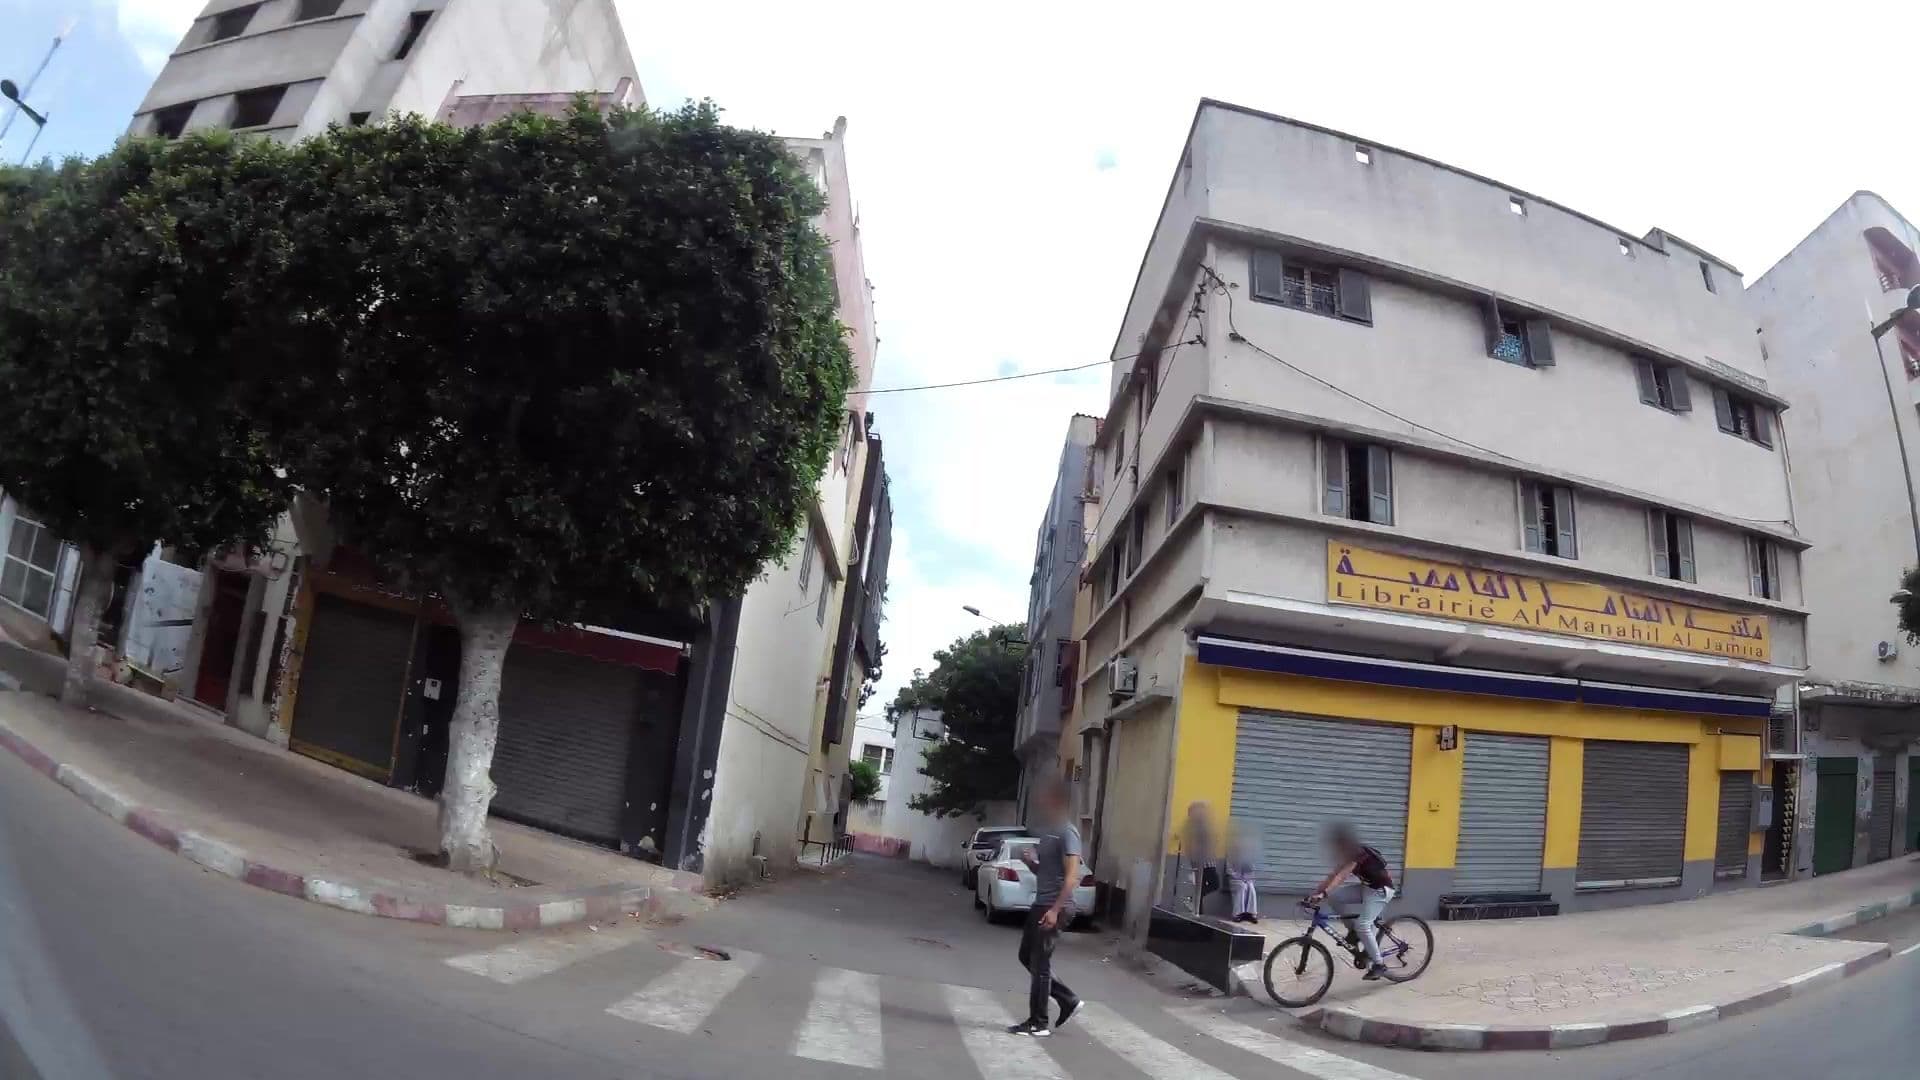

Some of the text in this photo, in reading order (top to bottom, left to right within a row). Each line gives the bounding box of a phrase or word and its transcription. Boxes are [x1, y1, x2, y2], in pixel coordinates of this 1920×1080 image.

[1336, 581, 1496, 619] Librairie
[1512, 608, 1541, 626] Al
[1558, 613, 1660, 643] Manahil
[1672, 632, 1692, 647] Al
